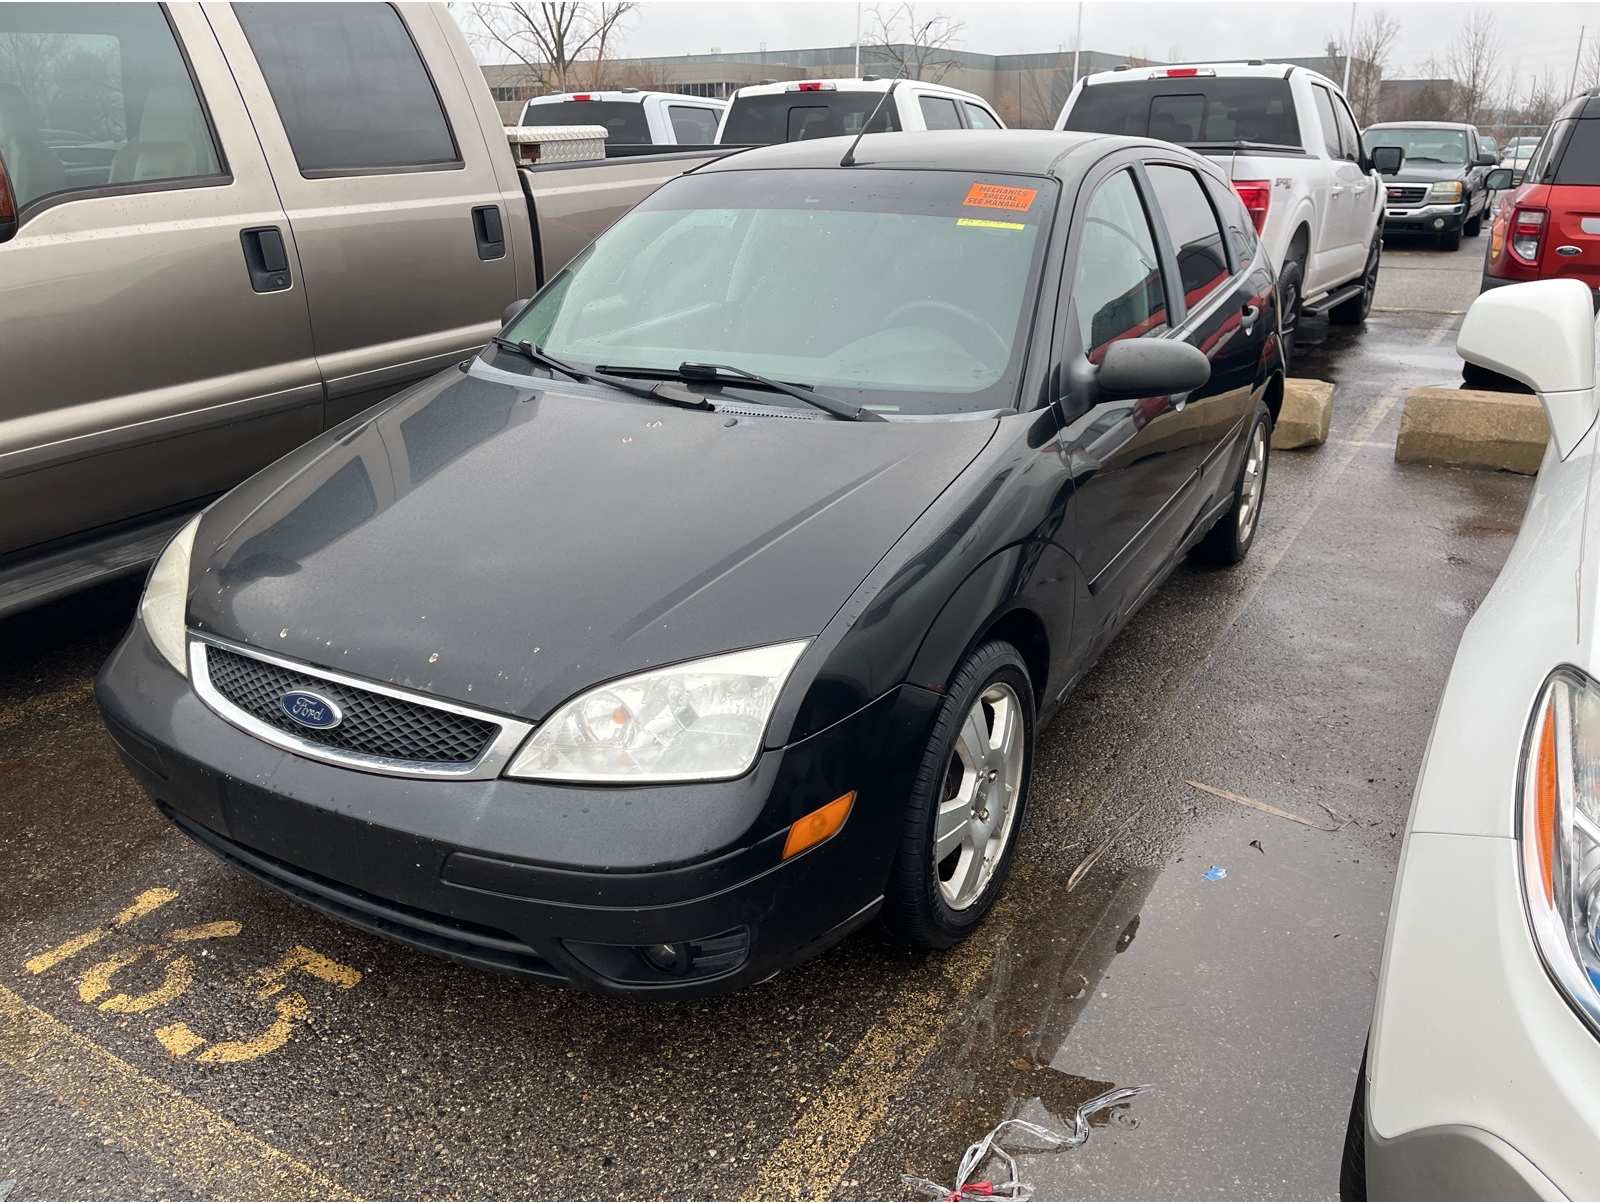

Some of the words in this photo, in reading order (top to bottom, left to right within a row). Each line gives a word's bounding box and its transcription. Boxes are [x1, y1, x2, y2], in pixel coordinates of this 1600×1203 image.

[983, 193, 1017, 201] SPECIAL
[984, 199, 1027, 209] MANAGER
[292, 697, 325, 721] Ford
